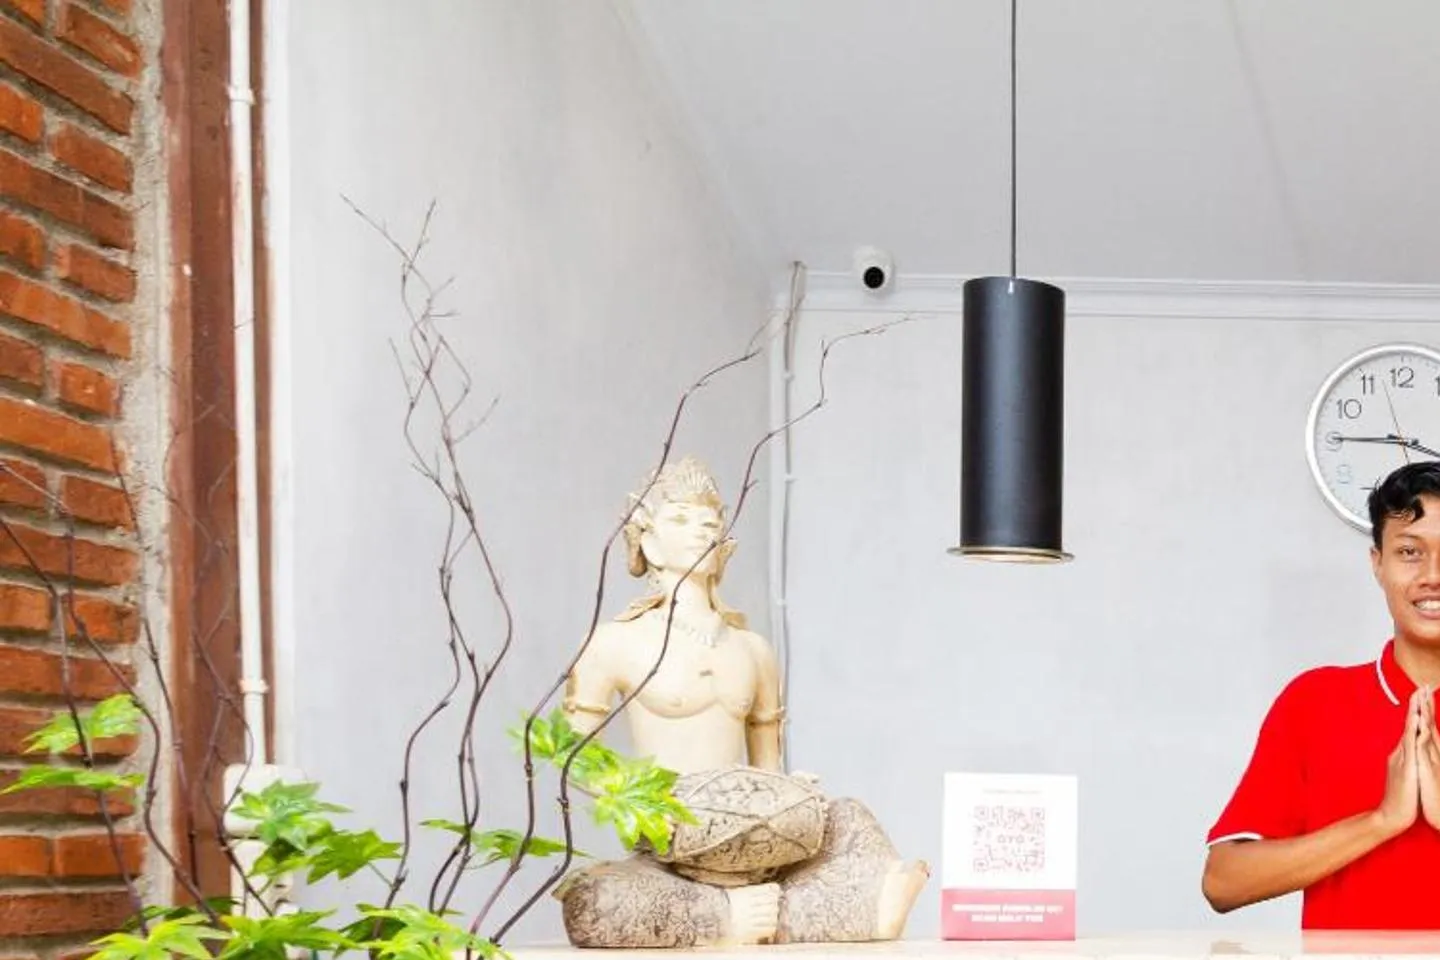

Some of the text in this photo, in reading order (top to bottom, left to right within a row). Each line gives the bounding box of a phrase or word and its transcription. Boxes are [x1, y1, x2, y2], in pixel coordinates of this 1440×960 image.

[1360, 374, 1375, 395] 11
[1389, 366, 1415, 389] 12
[1336, 398, 1363, 420] 10
[1325, 430, 1343, 452] 9
[1335, 463, 1354, 485] 8
